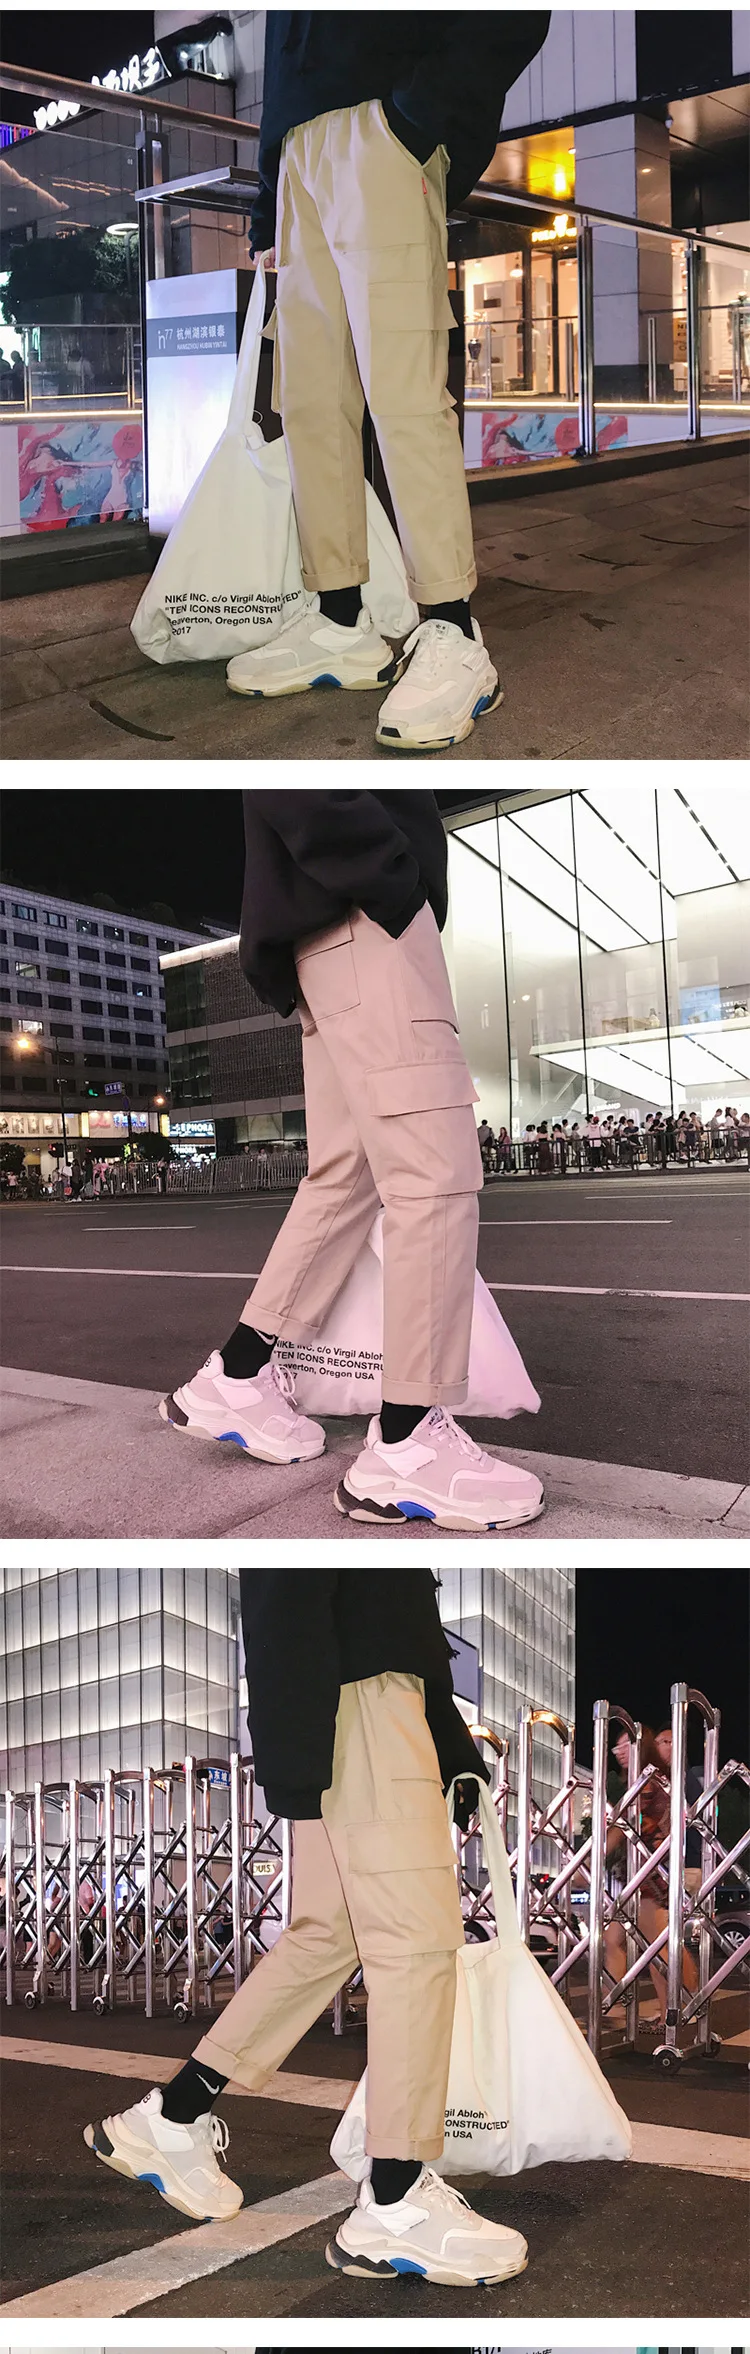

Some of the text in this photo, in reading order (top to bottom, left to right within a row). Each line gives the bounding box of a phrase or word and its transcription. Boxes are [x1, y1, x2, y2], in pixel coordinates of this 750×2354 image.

[176, 324, 226, 340] 杭州湖滨银泰
[165, 593, 187, 603] NIKE
[190, 593, 209, 603] INC.
[212, 594, 228, 603] c/o
[230, 594, 254, 604] Virgil
[190, 604, 221, 614] ICONS
[167, 617, 212, 626] eaverton,
[215, 616, 250, 626] Oregon
[317, 1346, 331, 1354] c/o
[334, 1347, 356, 1358] Virgil
[297, 1352, 325, 1364] ICONS
[319, 1367, 352, 1378] Oregon
[355, 1371, 375, 1380] USA
[445, 2119, 510, 2130] ONSTRUCTED"
[453, 2131, 473, 2139] USA
